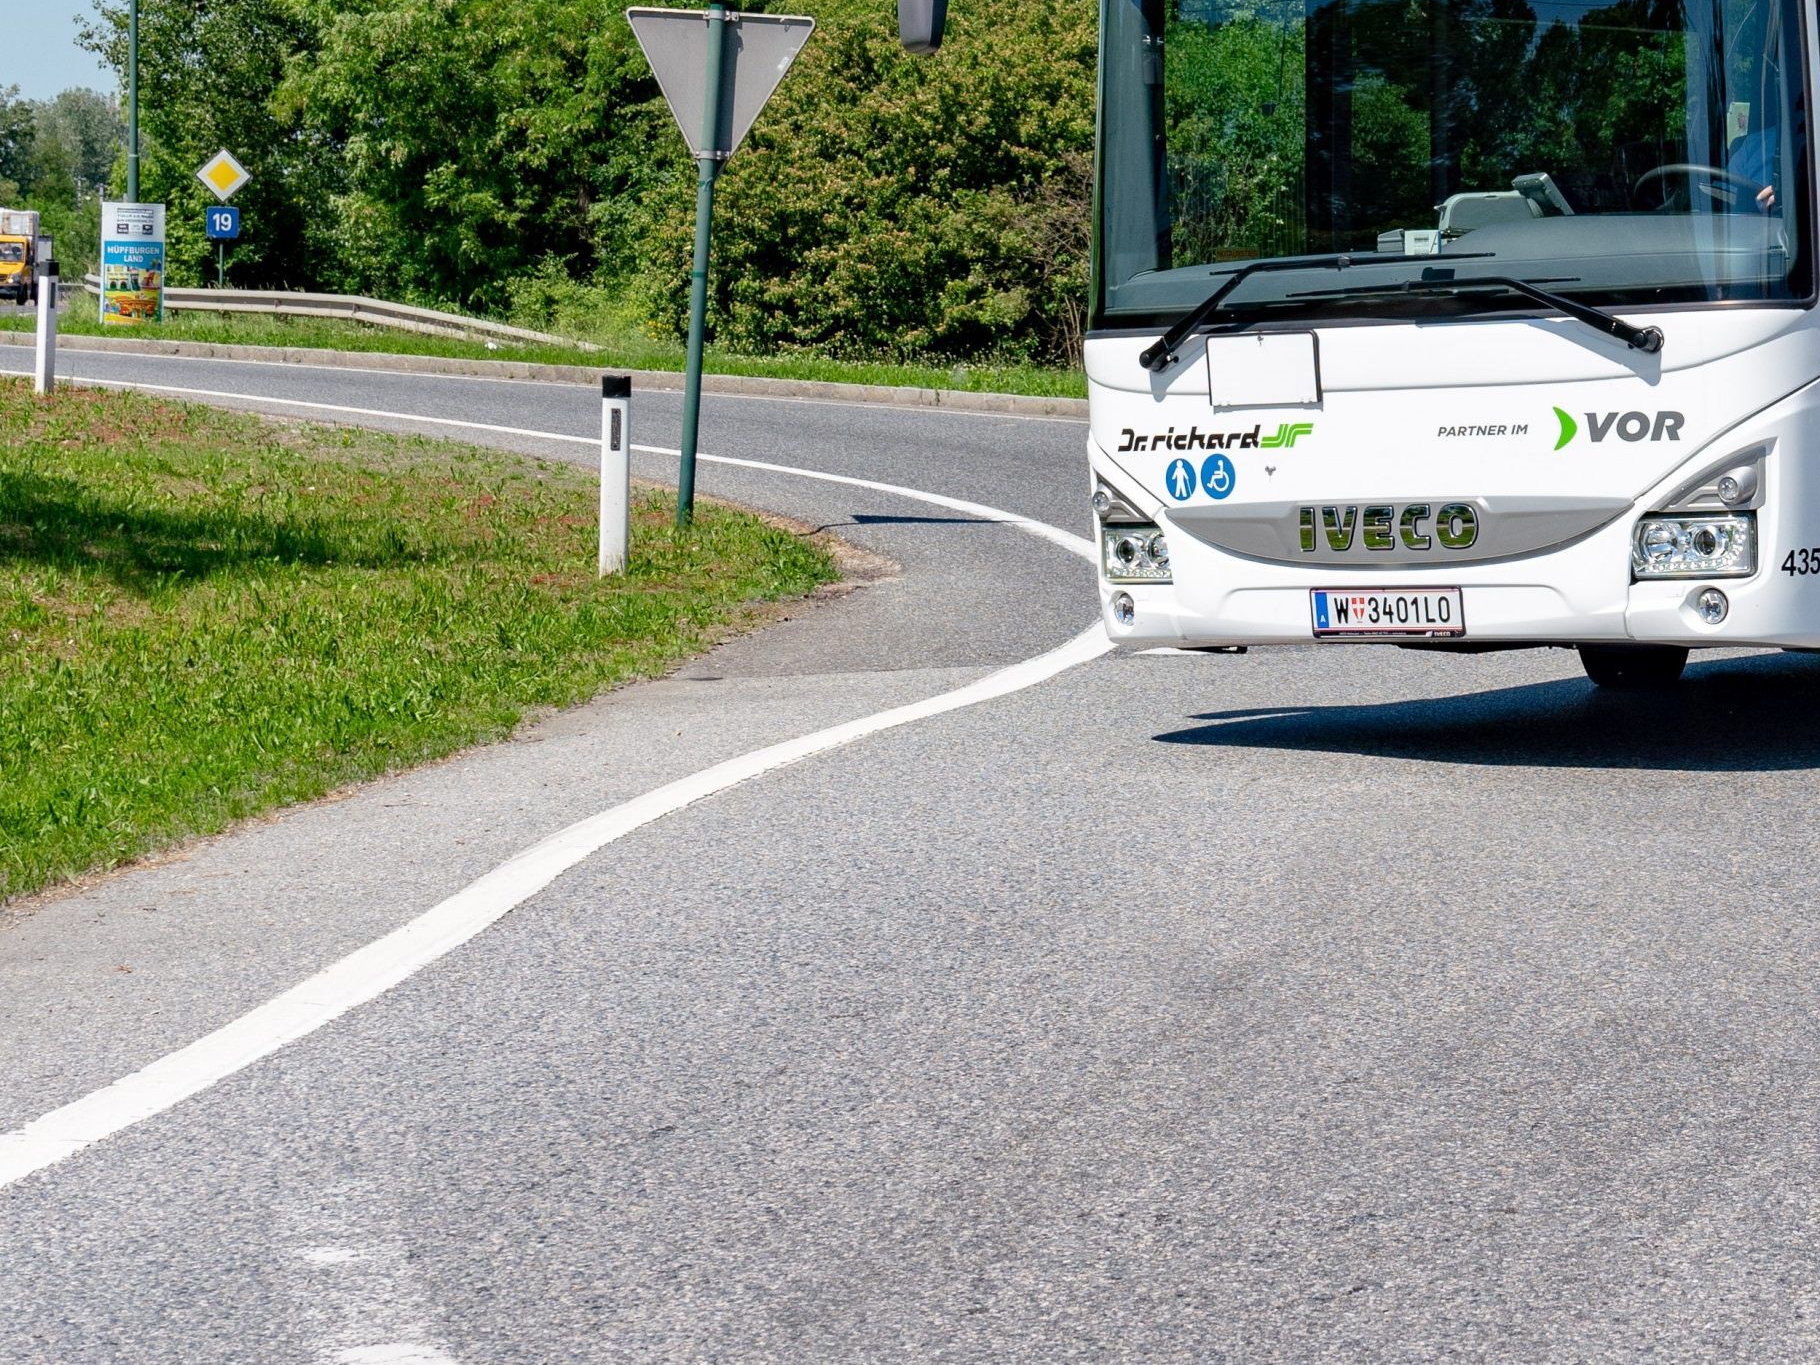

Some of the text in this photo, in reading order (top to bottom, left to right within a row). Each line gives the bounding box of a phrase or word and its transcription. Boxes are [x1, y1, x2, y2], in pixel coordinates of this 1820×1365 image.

[212, 213, 232, 232] 19
[107, 245, 160, 255] HÜPFBURGEN
[123, 254, 144, 263] LAND
[1437, 424, 1529, 437] PARTNER IM
[1583, 410, 1685, 442] VOR
[1299, 502, 1479, 553] IVECO
